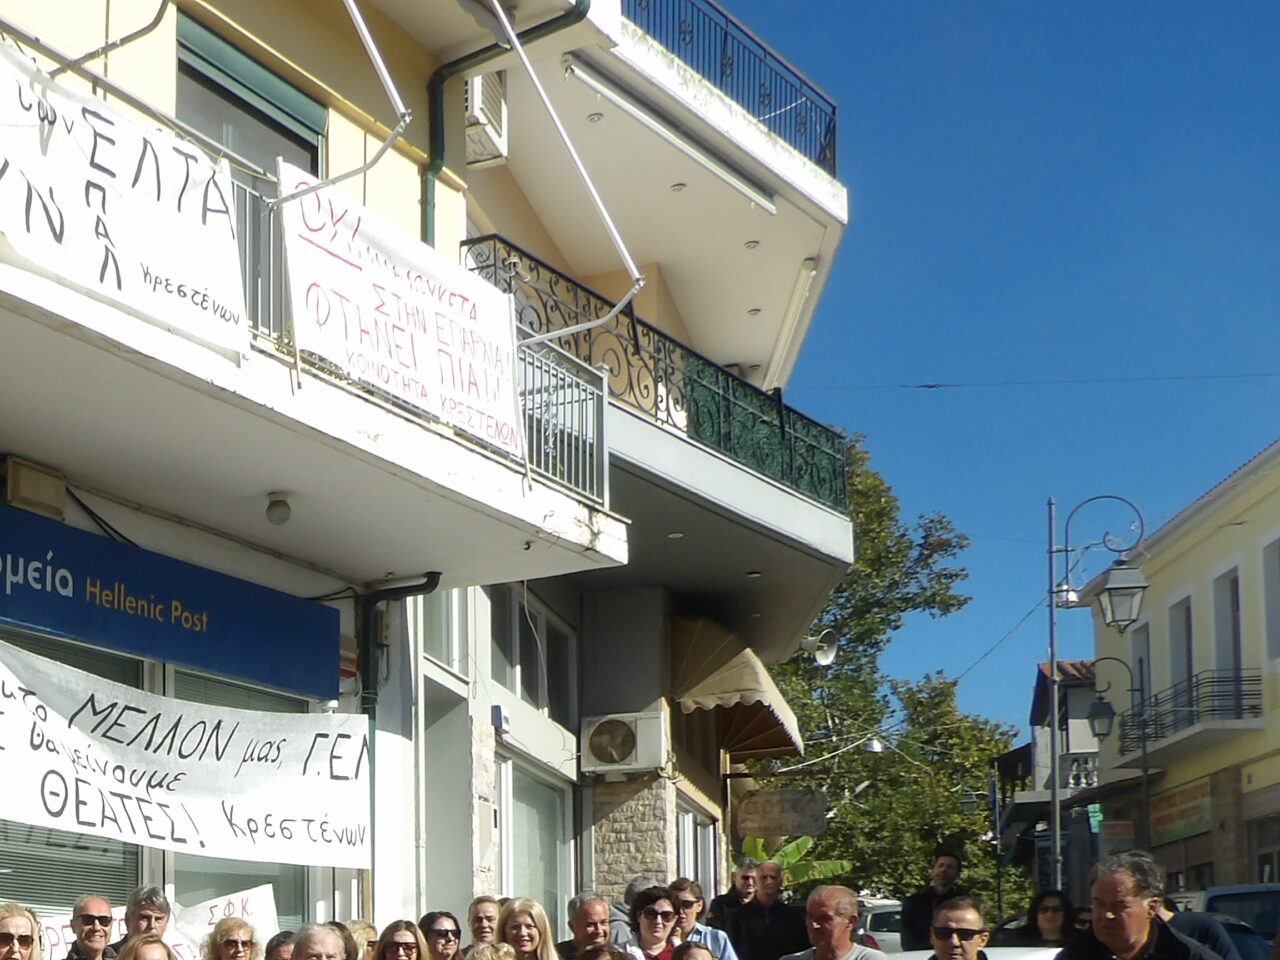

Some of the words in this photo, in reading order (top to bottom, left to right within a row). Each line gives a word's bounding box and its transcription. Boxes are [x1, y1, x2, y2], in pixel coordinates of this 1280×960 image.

[82, 105, 236, 241] ΕΛΤΑ
[372, 282, 428, 337] ΣΤΗΝ
[85, 576, 164, 623] Hellenic
[170, 595, 209, 633] Post
[30, 720, 61, 755] θα
[68, 693, 240, 762] ΜΕΛΛΟΝ
[40, 769, 207, 849] ΘΕΑΤΕΣ!
[221, 799, 367, 846] Κρεστένων
